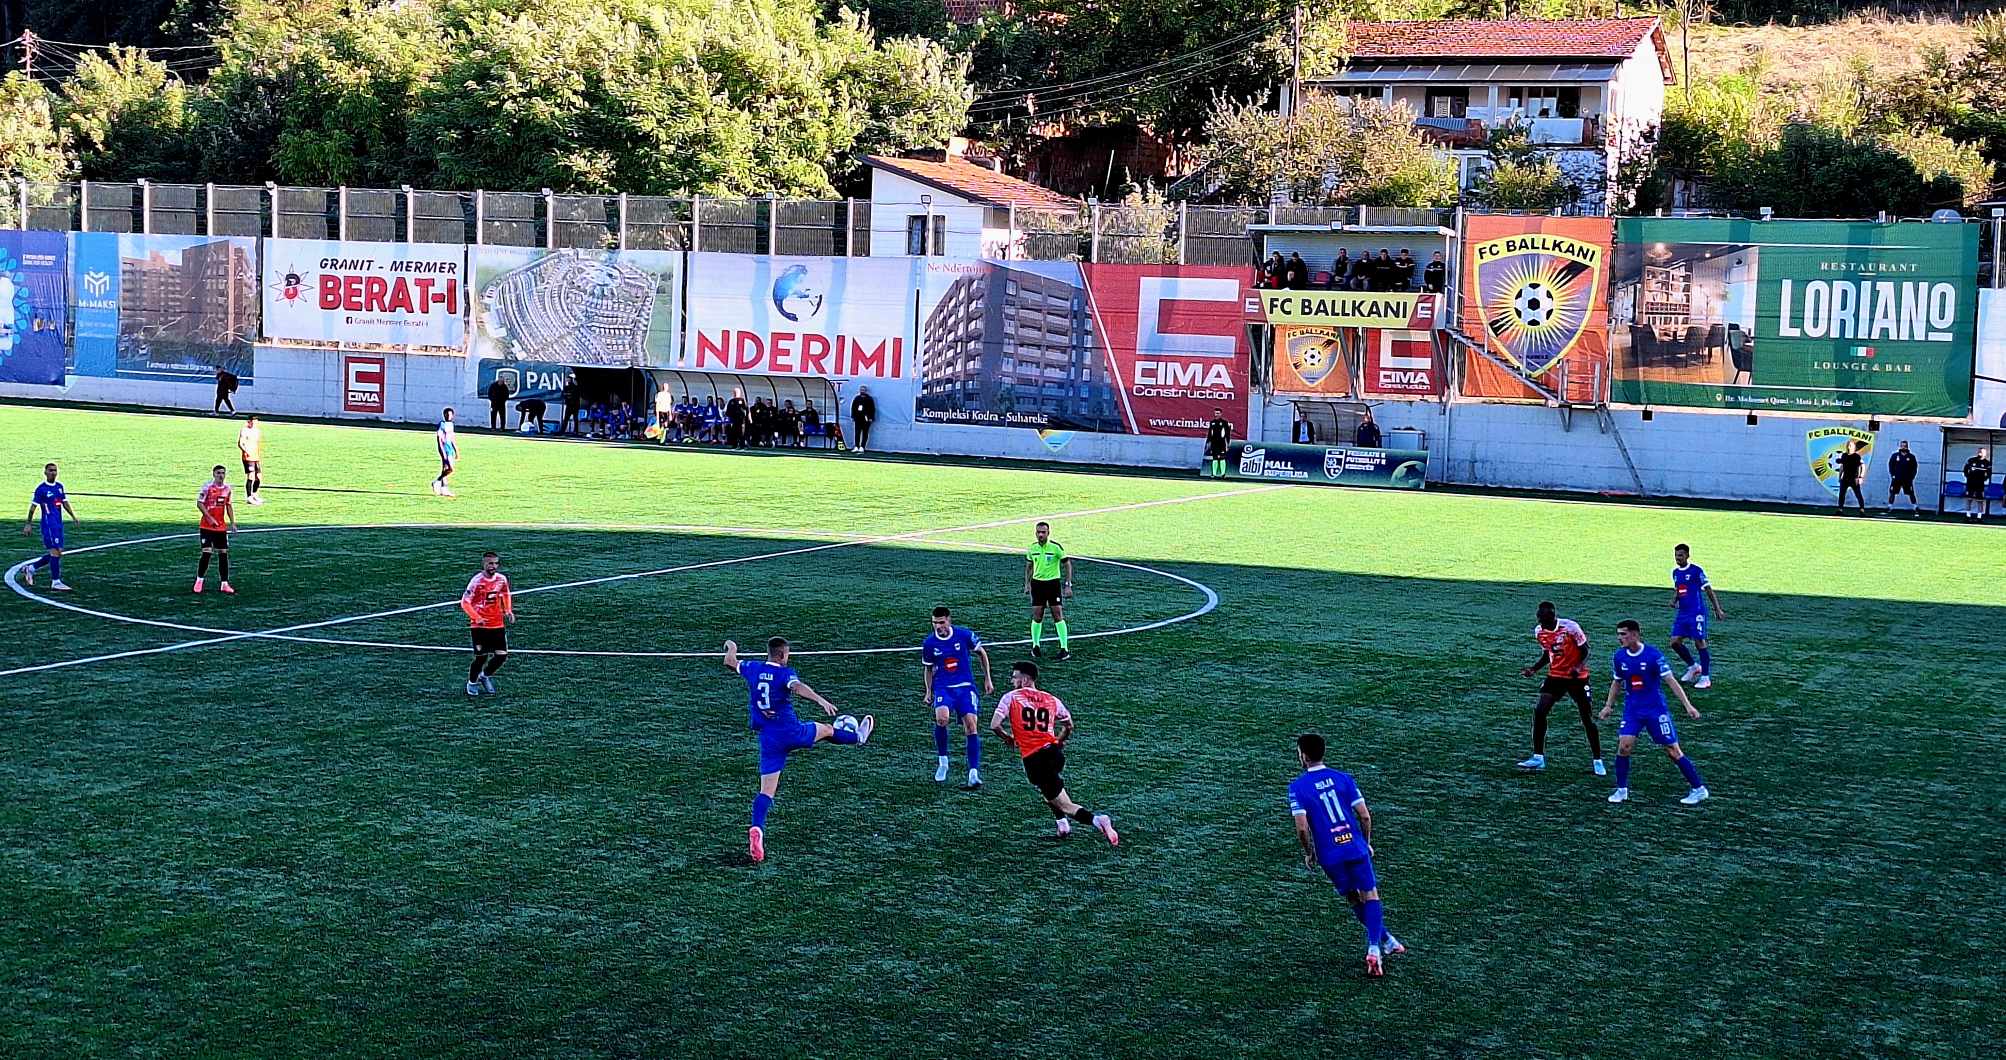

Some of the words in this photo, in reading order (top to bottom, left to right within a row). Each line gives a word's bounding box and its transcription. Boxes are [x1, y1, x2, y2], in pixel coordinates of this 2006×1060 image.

[1478, 244, 1500, 260] FC
[1505, 237, 1596, 262] BALLKANI
[319, 258, 374, 271] GRANIT
[389, 260, 457, 275] MERMER
[1820, 262, 1918, 272] RESTAURANT
[319, 274, 457, 315] BERAT-I
[1269, 297, 1293, 316] FC
[1300, 299, 1408, 319] BALLKANI
[695, 329, 903, 378] NDERIMI
[1134, 361, 1235, 389] CIMA
[1814, 361, 1867, 371] LOUNGE
[1872, 363, 1880, 371] &
[1885, 364, 1913, 373] BAR
[1379, 370, 1431, 385] CIMA
[348, 391, 380, 402] CIMA
[1132, 384, 1236, 401] Construction
[921, 407, 969, 421] Kompleksi
[972, 409, 999, 421] Kodra
[1823, 428, 1872, 442] BALLKANI
[1264, 460, 1294, 470] MALL
[757, 682, 770, 710] 3
[1021, 706, 1050, 733] 99
[1319, 789, 1346, 824] 11
